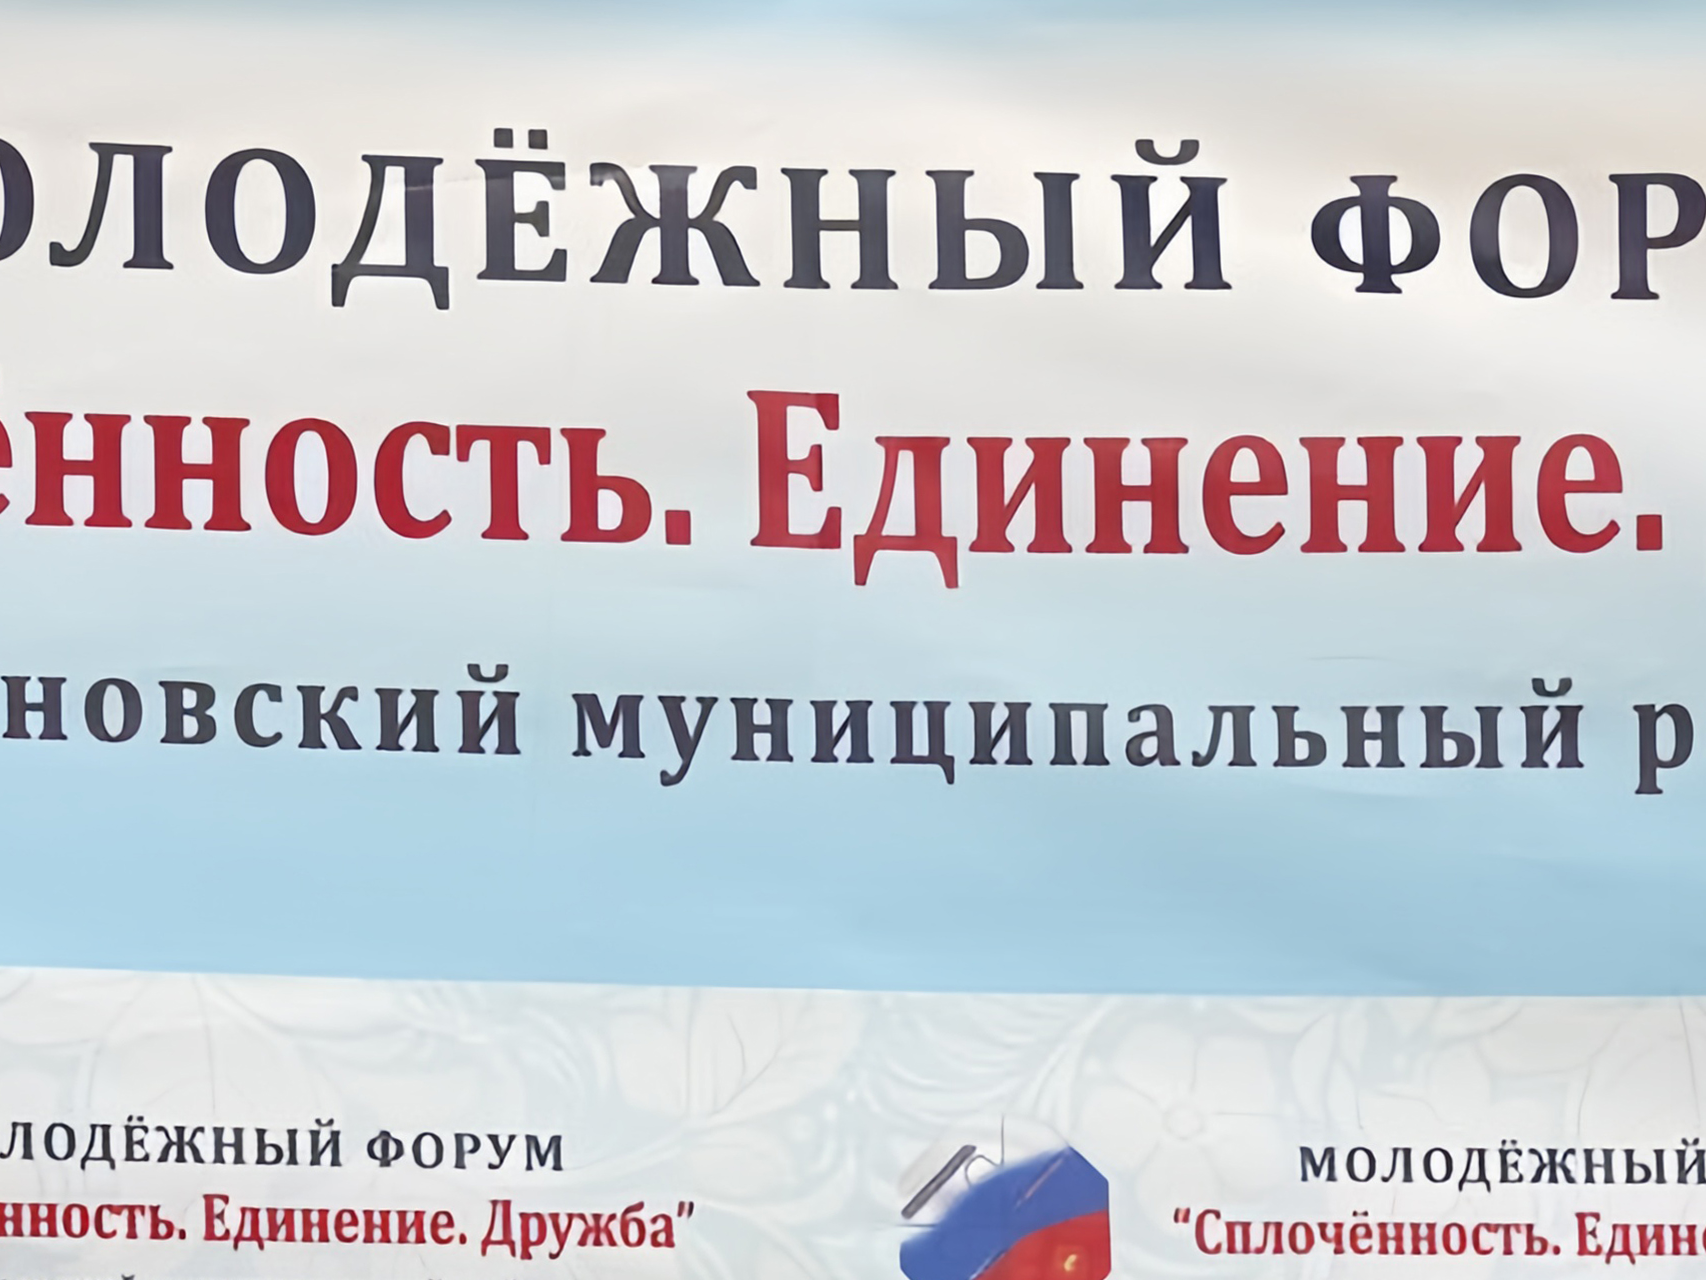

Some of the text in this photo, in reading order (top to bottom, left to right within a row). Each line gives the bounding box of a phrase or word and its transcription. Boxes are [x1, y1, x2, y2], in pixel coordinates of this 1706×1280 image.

[747, 391, 1662, 588] Единение.
[572, 678, 1584, 786] муниципальный
[367, 1130, 563, 1171] ФОРУМ
[1300, 1138, 1706, 1192] МОЛОДЁЖНЫЙ
[203, 1194, 467, 1250] Единение.
